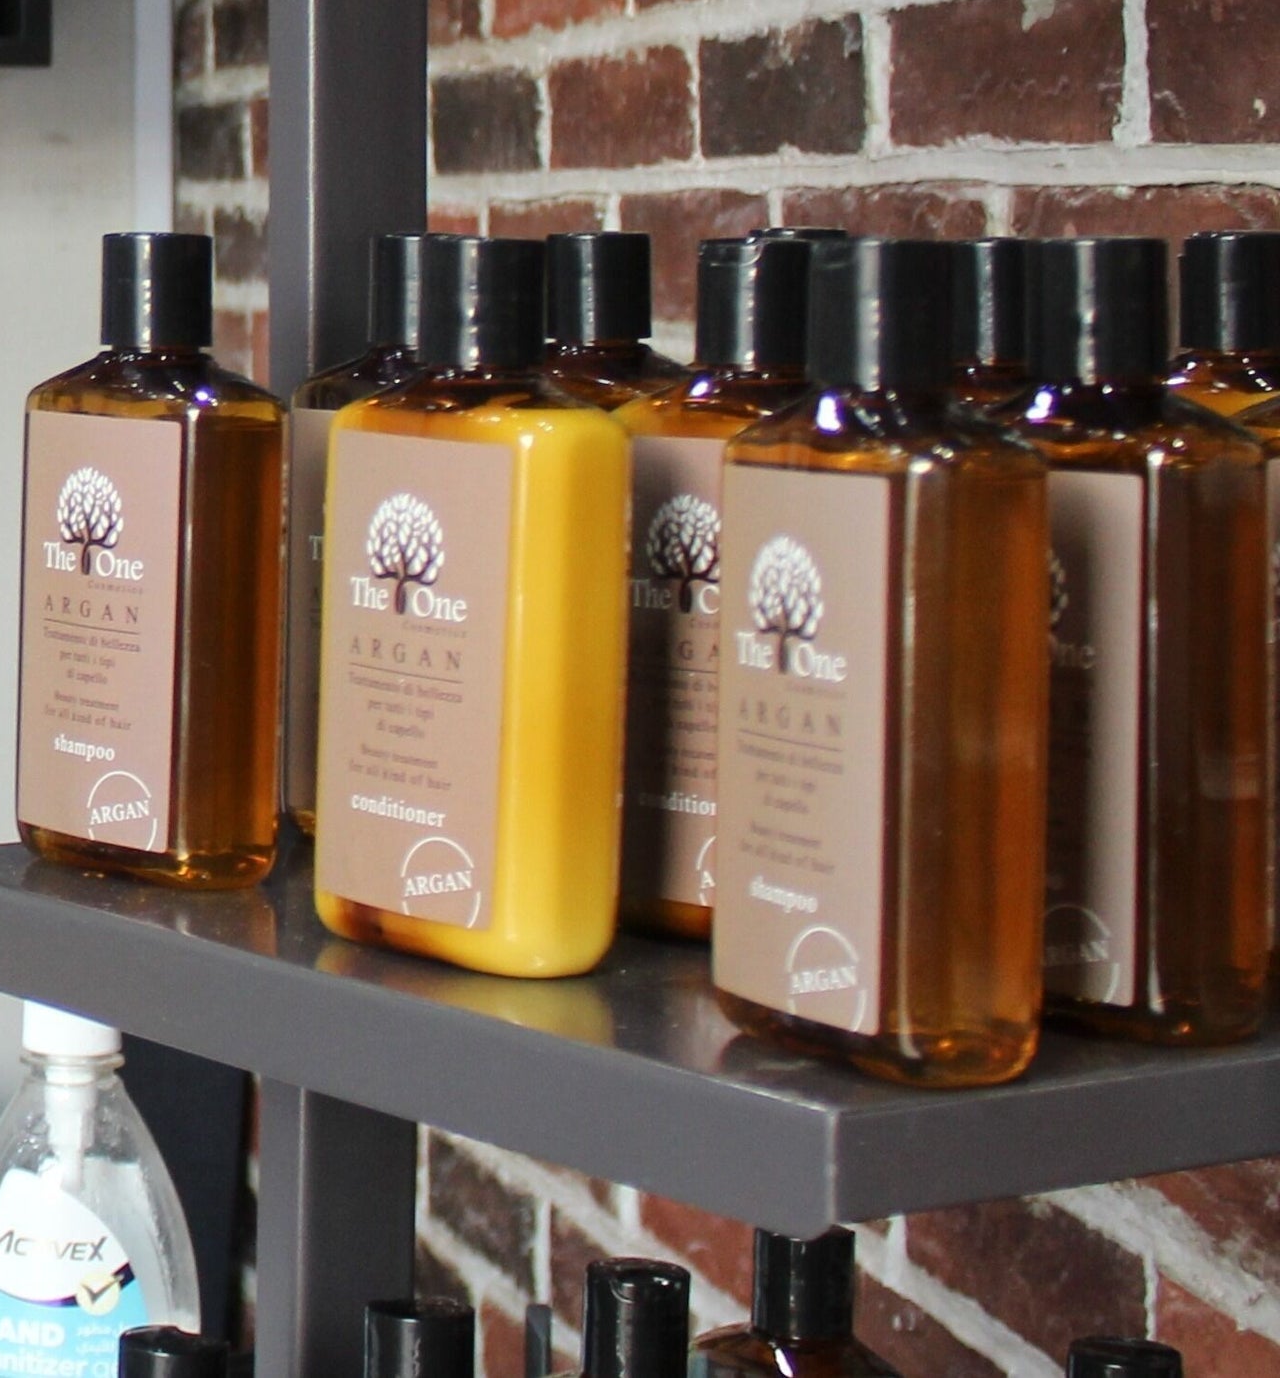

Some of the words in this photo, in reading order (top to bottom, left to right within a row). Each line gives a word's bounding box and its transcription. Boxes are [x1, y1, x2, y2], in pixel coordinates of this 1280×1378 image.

[43, 541, 77, 572] The
[95, 550, 144, 581] One
[44, 594, 139, 625] ARGAN
[350, 576, 389, 610] The
[412, 586, 468, 622] One
[349, 635, 462, 670] ARGAN
[736, 631, 773, 670] The
[793, 642, 848, 683] One
[54, 733, 116, 762] shampoo
[90, 800, 149, 825] ARGAN
[351, 794, 446, 827] conditioner
[404, 870, 472, 897] ARGAN
[750, 875, 819, 914] shampoo
[790, 965, 857, 995] ARGAN
